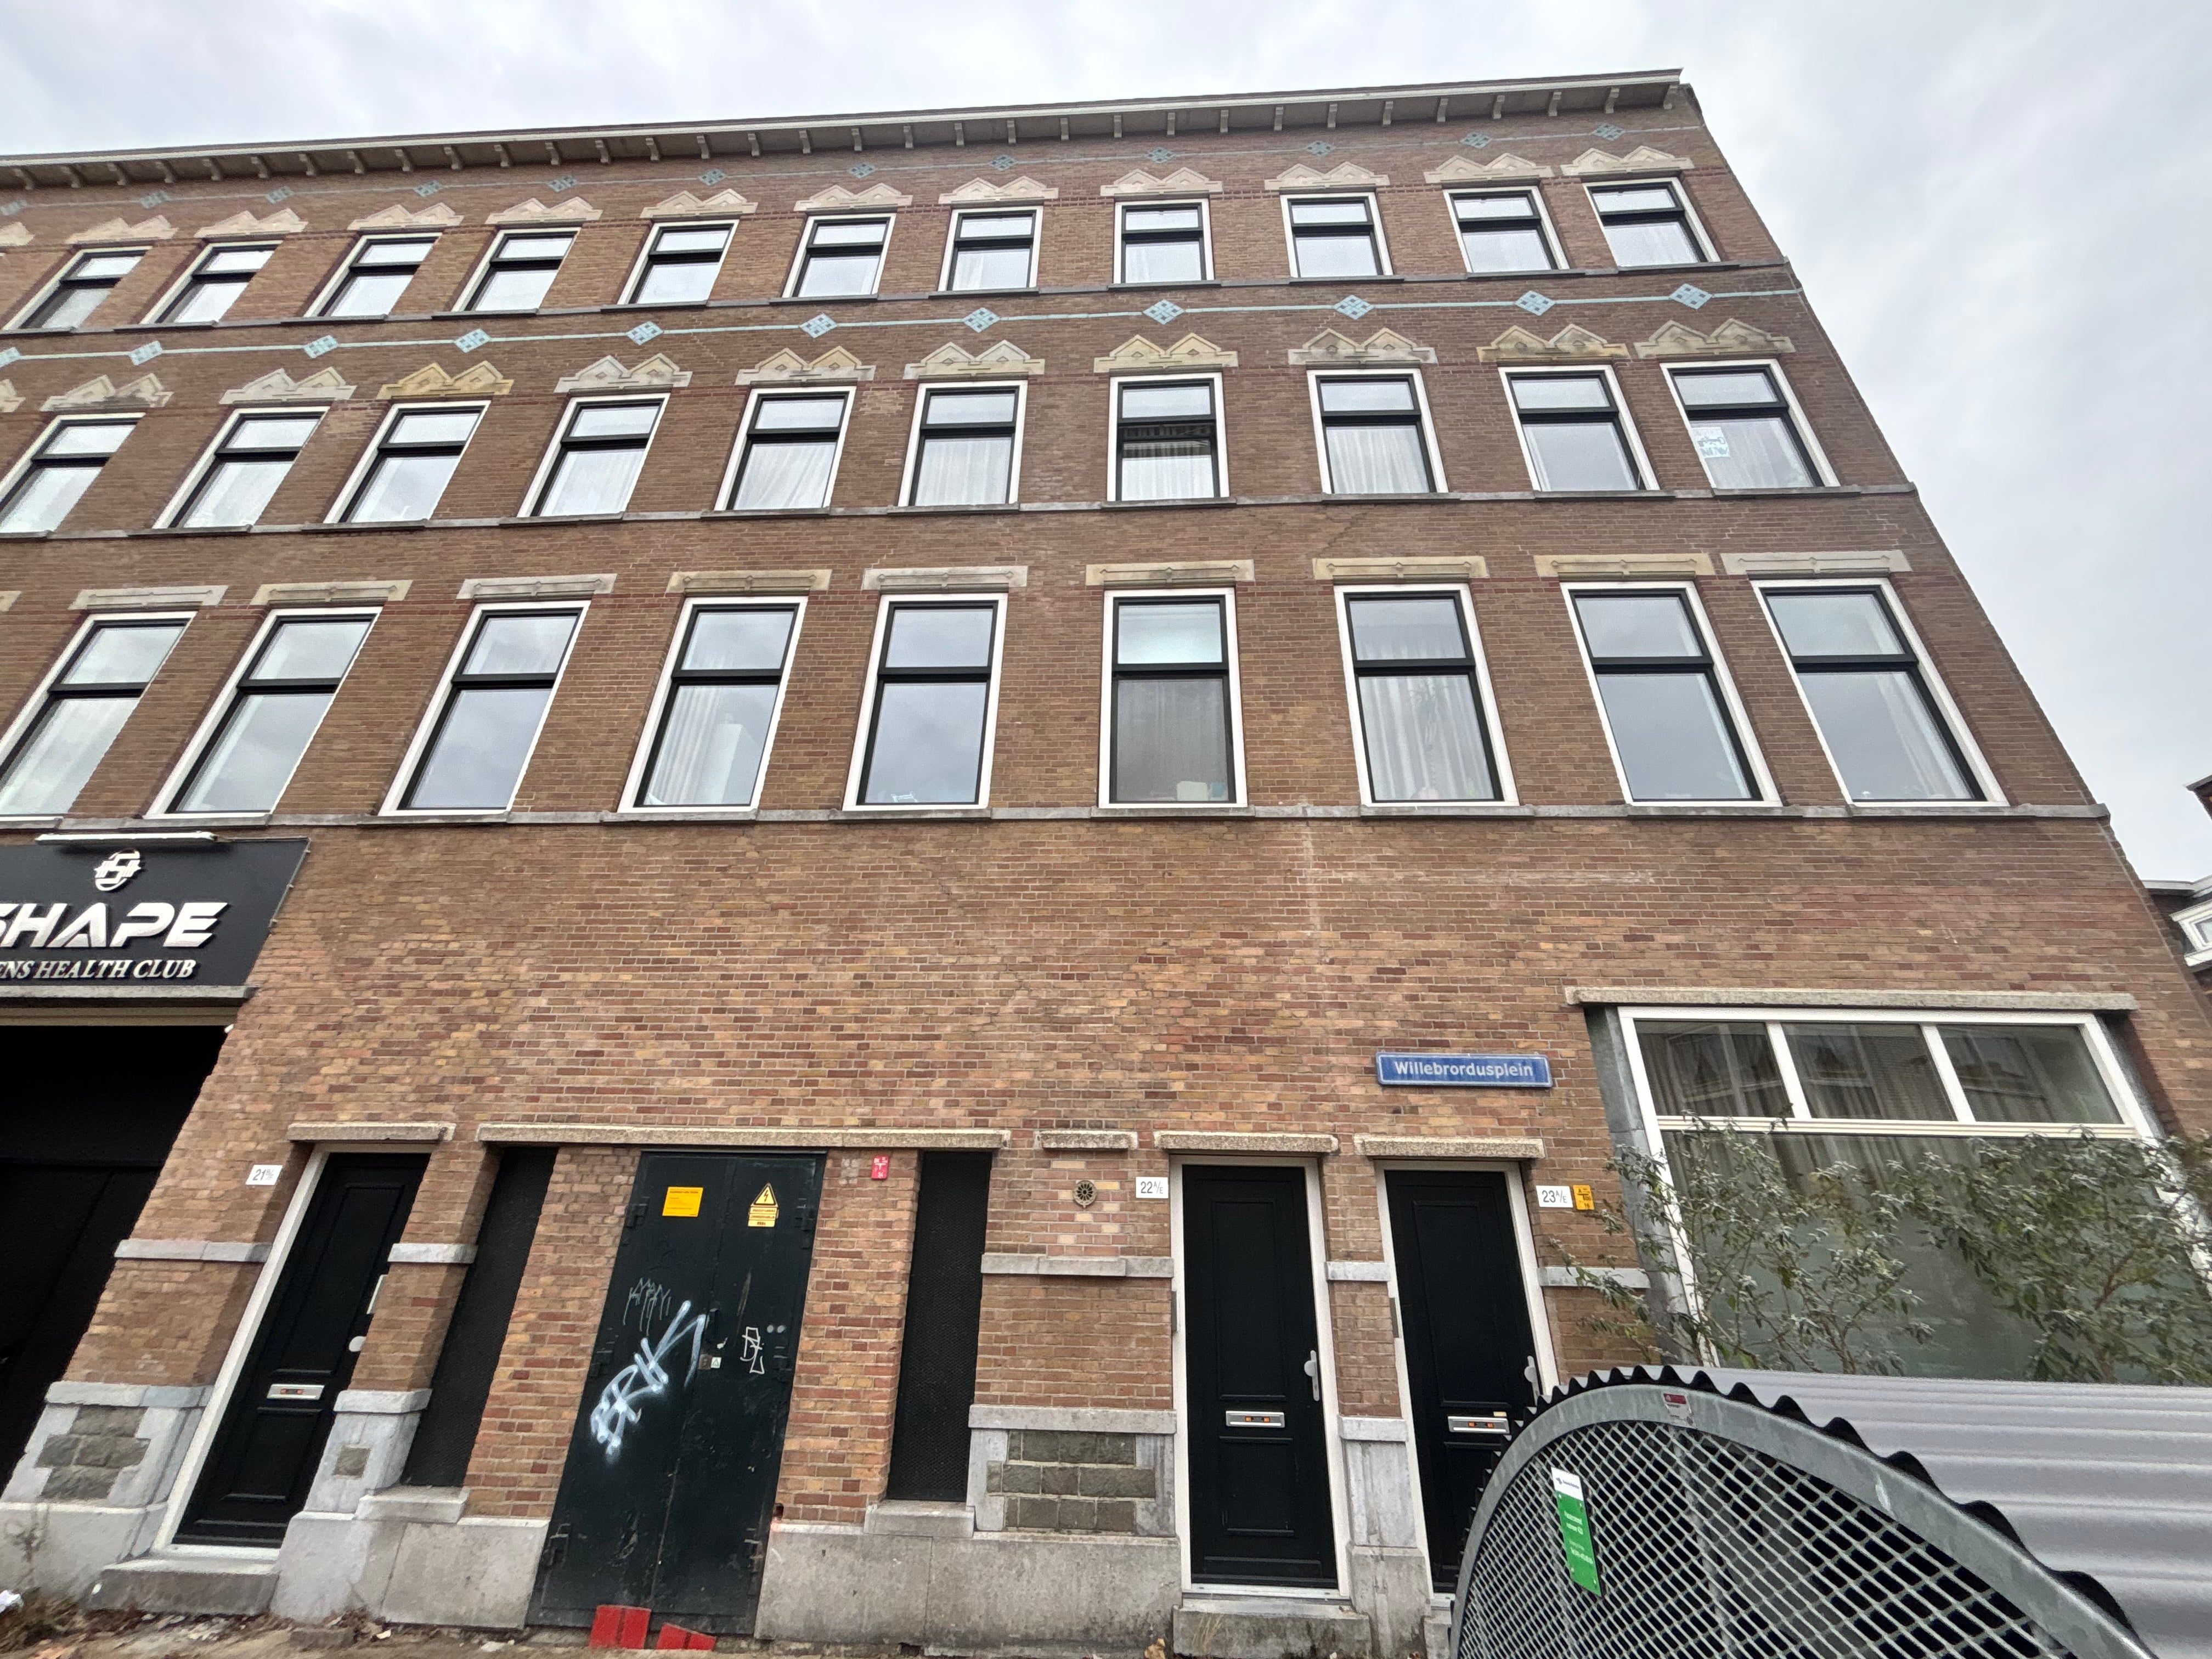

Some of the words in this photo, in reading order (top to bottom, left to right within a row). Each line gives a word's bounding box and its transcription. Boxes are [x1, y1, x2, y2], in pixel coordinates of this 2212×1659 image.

[33, 960, 133, 978] HEALTH
[133, 960, 196, 978] CLUB
[1394, 1061, 1533, 1079] Willebrordusplein
